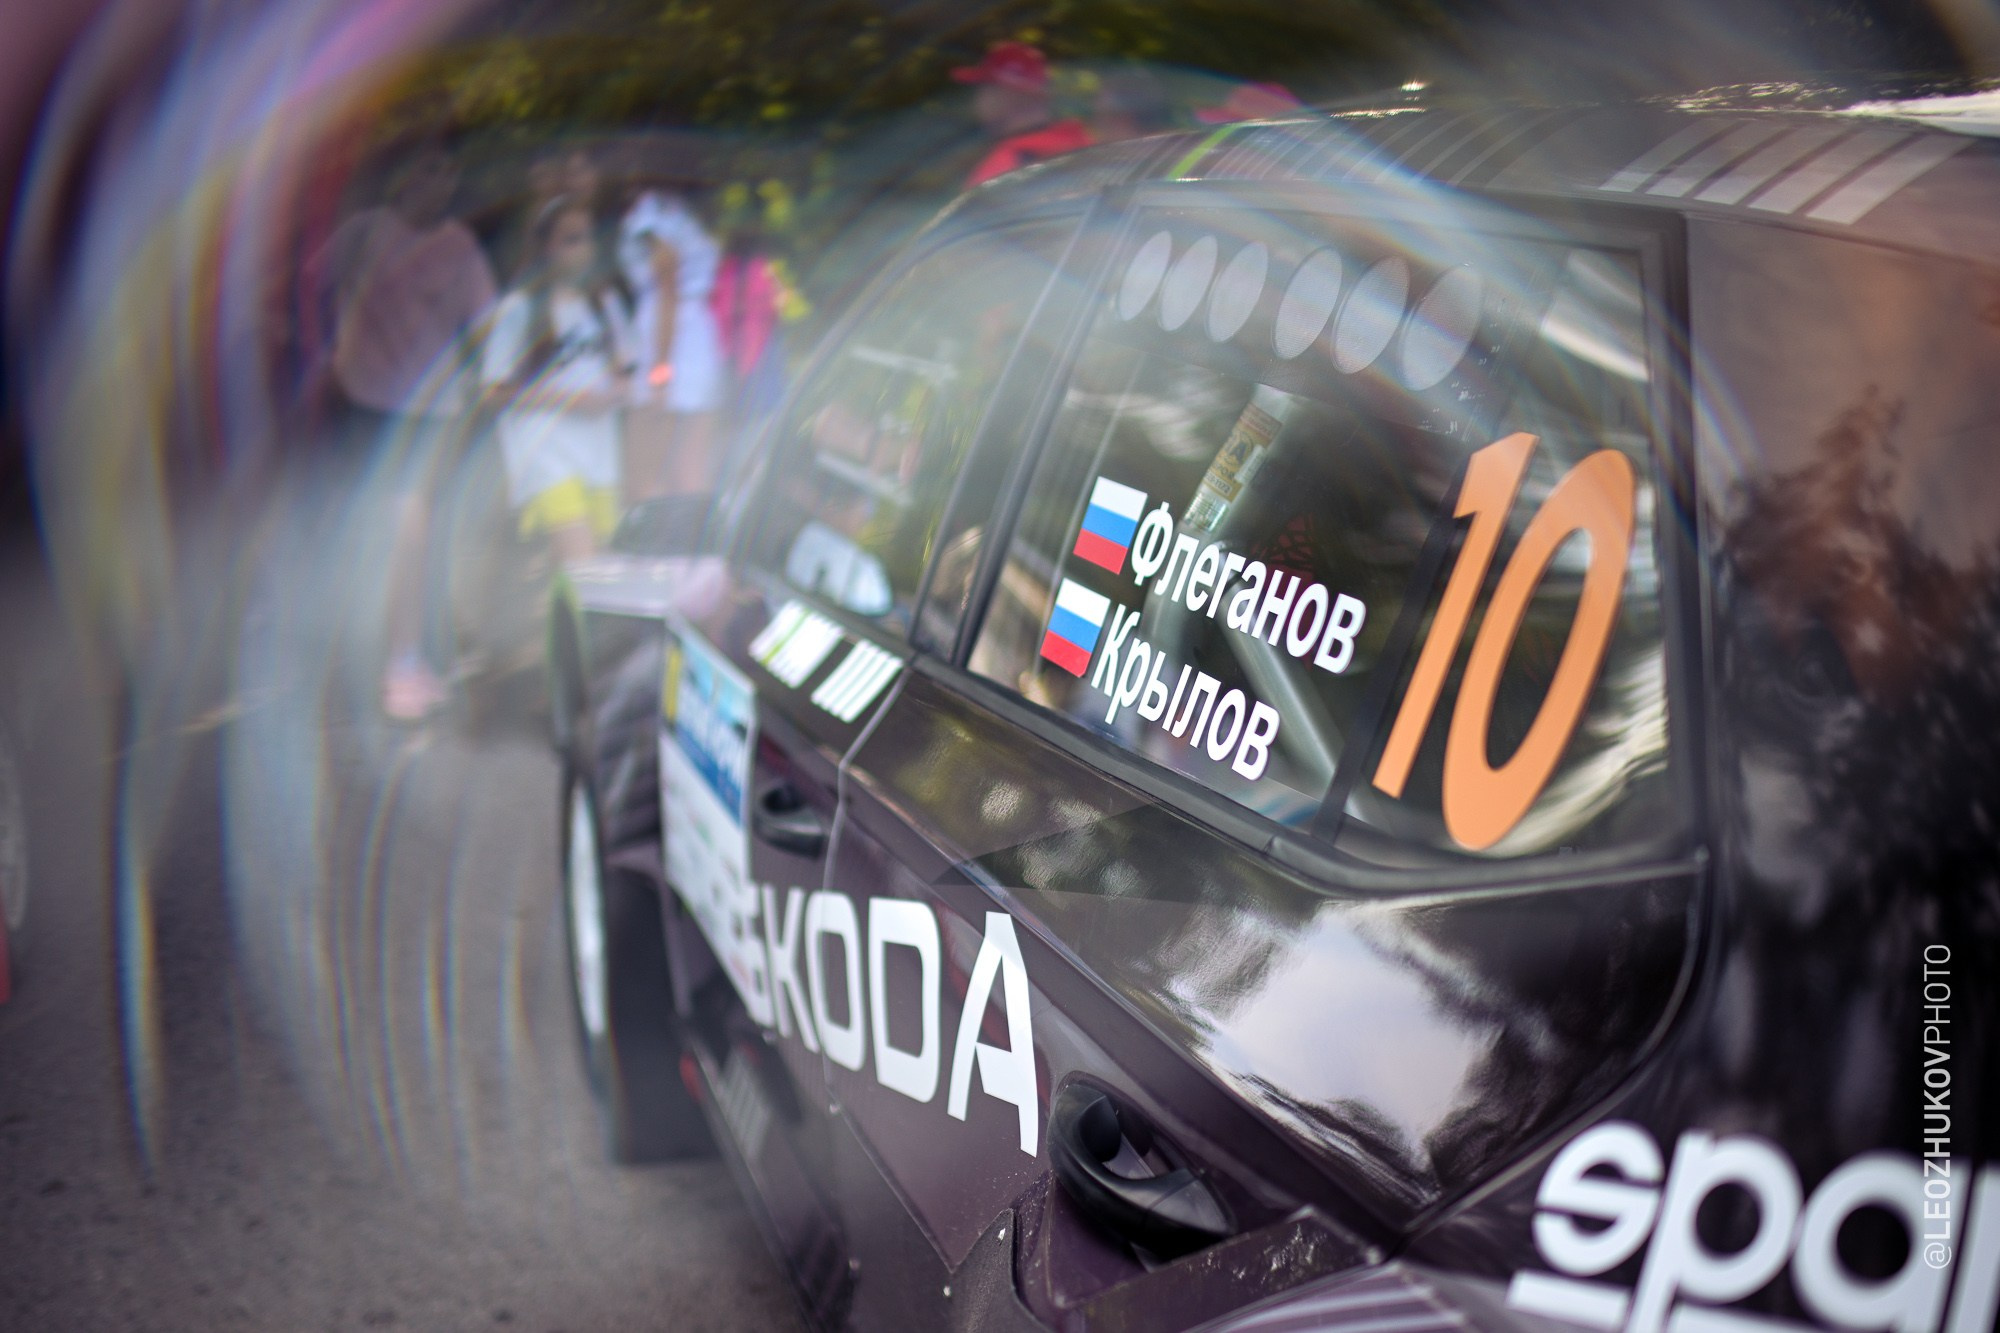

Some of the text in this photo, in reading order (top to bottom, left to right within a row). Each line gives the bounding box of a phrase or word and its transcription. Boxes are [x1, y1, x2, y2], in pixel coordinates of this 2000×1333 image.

[1130, 502, 1366, 674] Флеганов
[1372, 432, 1635, 851] 10
[1090, 604, 1280, 781] Крылов
